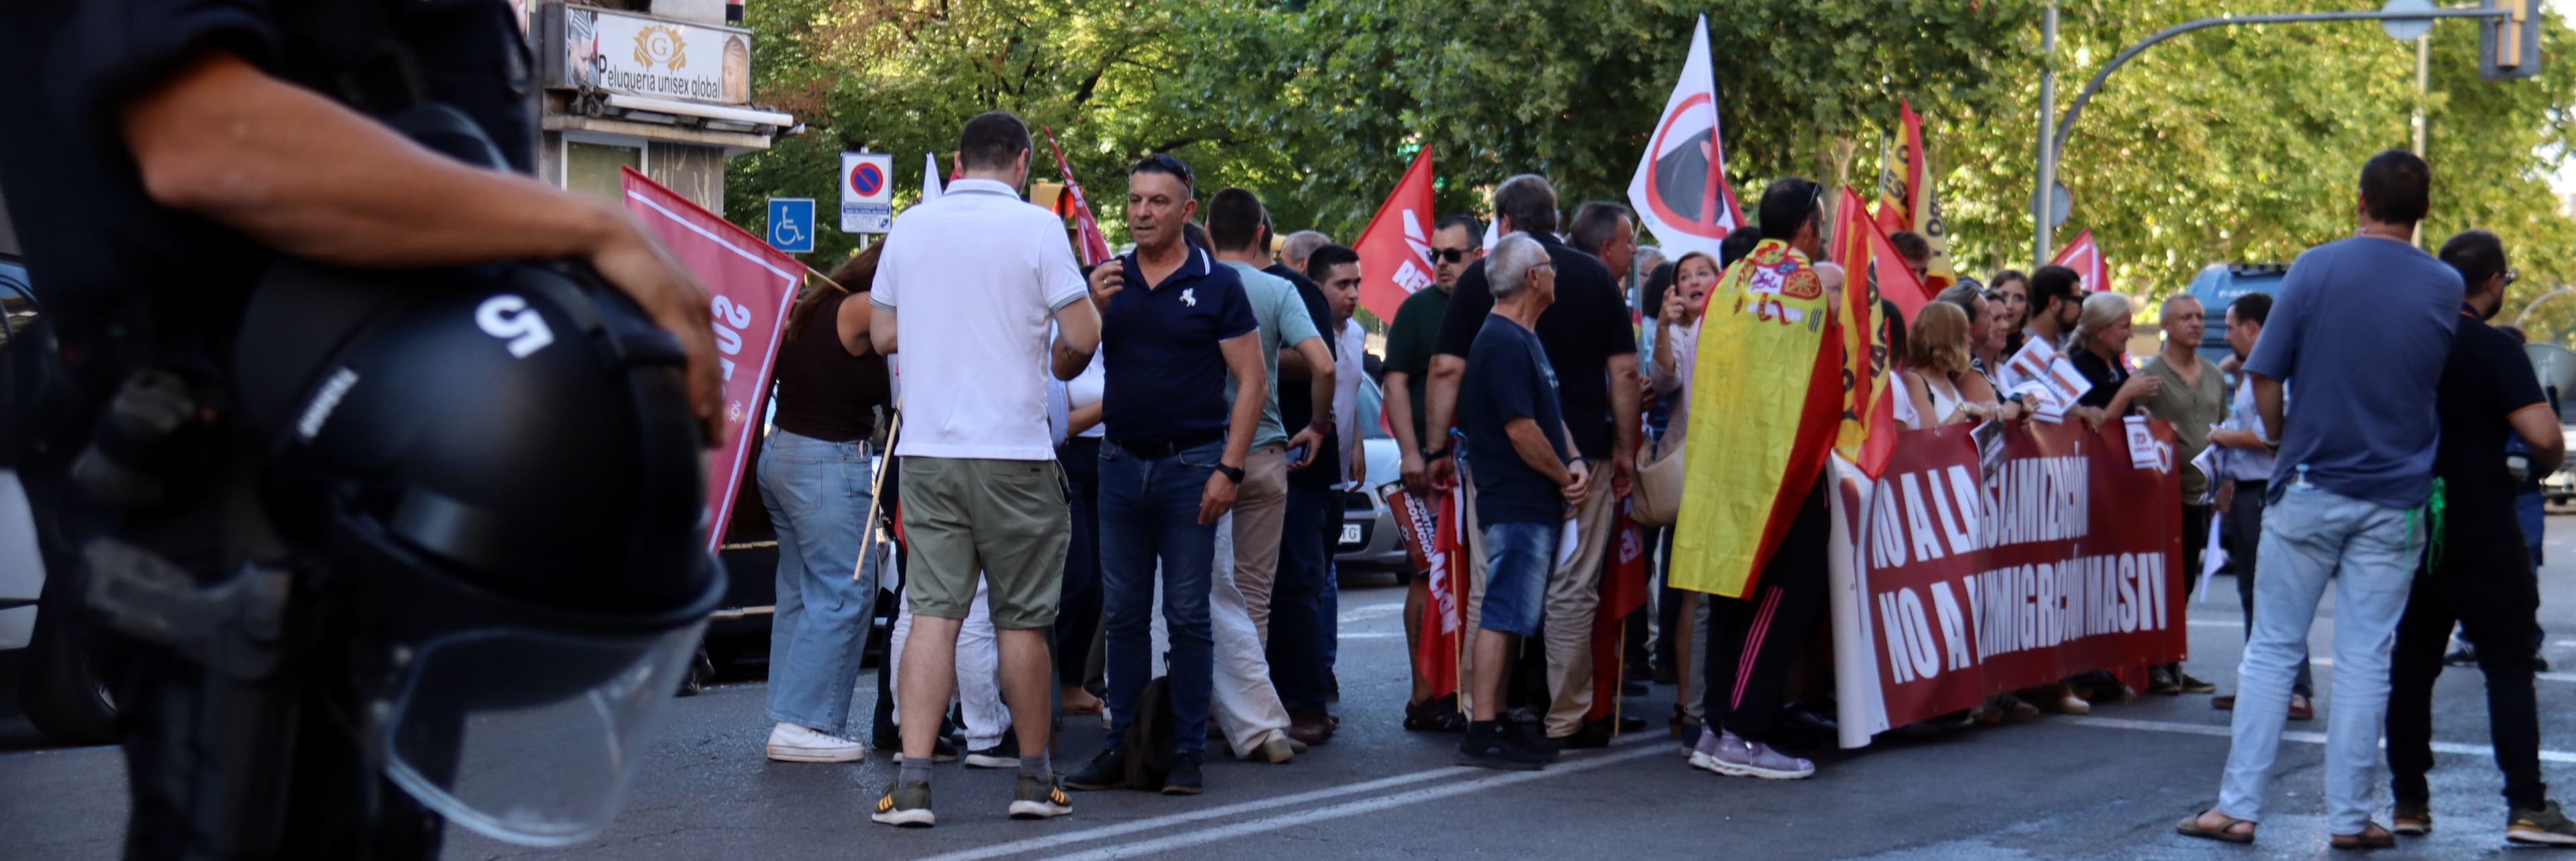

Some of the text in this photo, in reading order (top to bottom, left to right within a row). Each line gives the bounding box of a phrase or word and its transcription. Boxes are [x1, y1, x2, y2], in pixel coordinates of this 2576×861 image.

[651, 38, 667, 56] G
[658, 71, 689, 95] unisex
[692, 75, 720, 100] global
[474, 294, 555, 359] 5
[1900, 471, 1945, 562] A
[1927, 465, 1982, 555] LA
[1878, 587, 1940, 685] NO
[1929, 580, 1971, 672] A
[2086, 552, 2167, 636] MASIV
